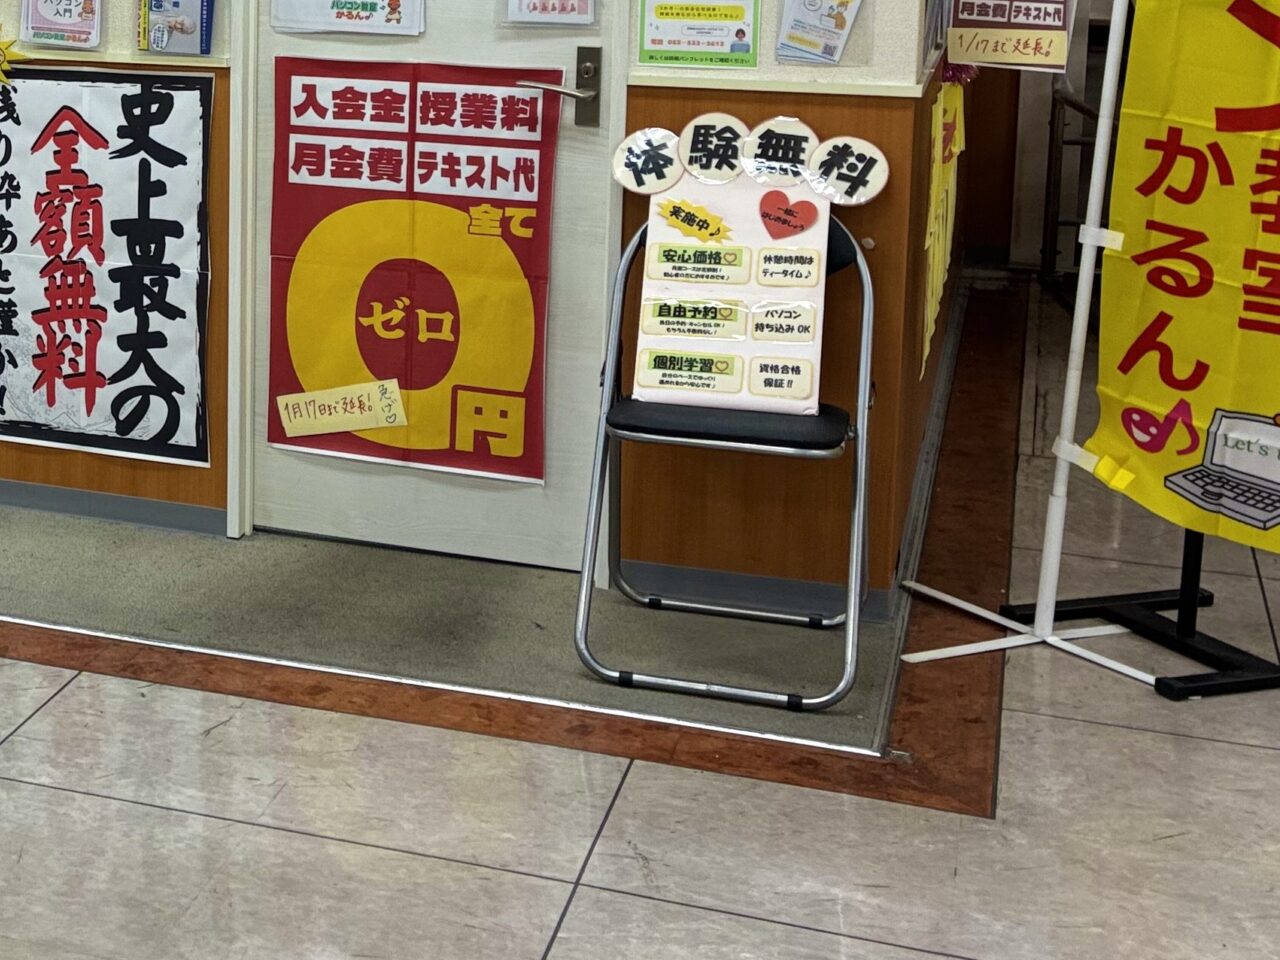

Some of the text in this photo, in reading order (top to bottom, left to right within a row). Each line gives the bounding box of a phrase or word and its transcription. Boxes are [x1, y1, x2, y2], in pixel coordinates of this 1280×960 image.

[53, 7, 73, 18] 入門
[959, 1, 1008, 19] 月会費
[293, 83, 539, 133] 入会金 授業料
[291, 143, 536, 194] 月会費 テキスト代
[623, 123, 879, 198] 体験無料
[467, 203, 538, 239] 全て
[669, 205, 710, 232] 実施中
[30, 105, 110, 418] 全額無料
[107, 83, 189, 445] 史上最大の
[662, 249, 723, 264] 安心価格
[763, 255, 814, 266] 休憩時間は
[1116, 125, 1235, 394] かるん
[358, 296, 457, 343] ゼロ
[657, 303, 718, 320] 自由予約
[765, 309, 802, 320] パソコン
[754, 323, 811, 334] 持ち込み OK
[653, 354, 715, 373] 個別学習
[759, 363, 802, 375] 資格合格
